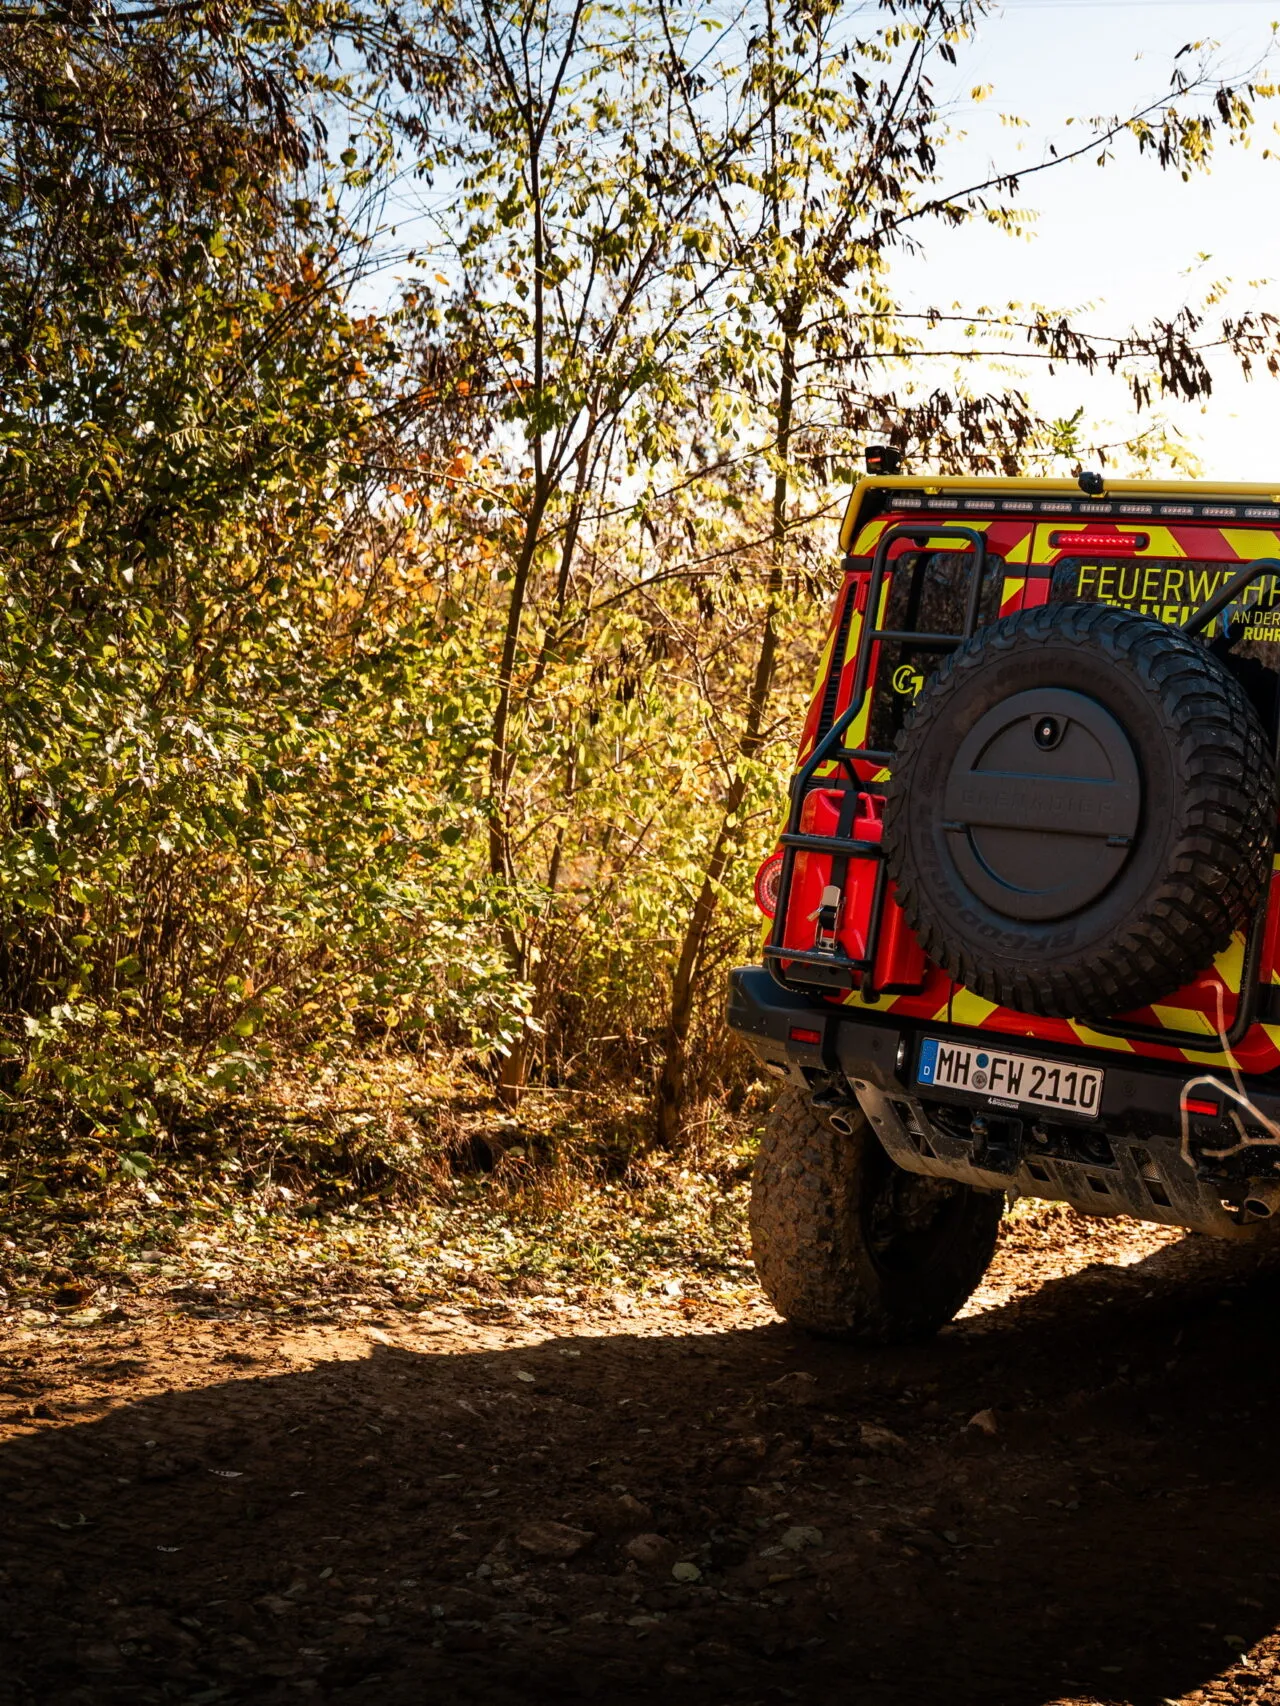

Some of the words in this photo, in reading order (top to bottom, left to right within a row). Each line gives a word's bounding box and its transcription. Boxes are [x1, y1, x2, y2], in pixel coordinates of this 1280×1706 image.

[1231, 610, 1251, 624] AN
[1253, 611, 1280, 626] DER
[923, 1065, 931, 1076] D
[936, 1047, 971, 1086] MH
[988, 1057, 1024, 1095] FW
[1028, 1065, 1097, 1109] 2110
